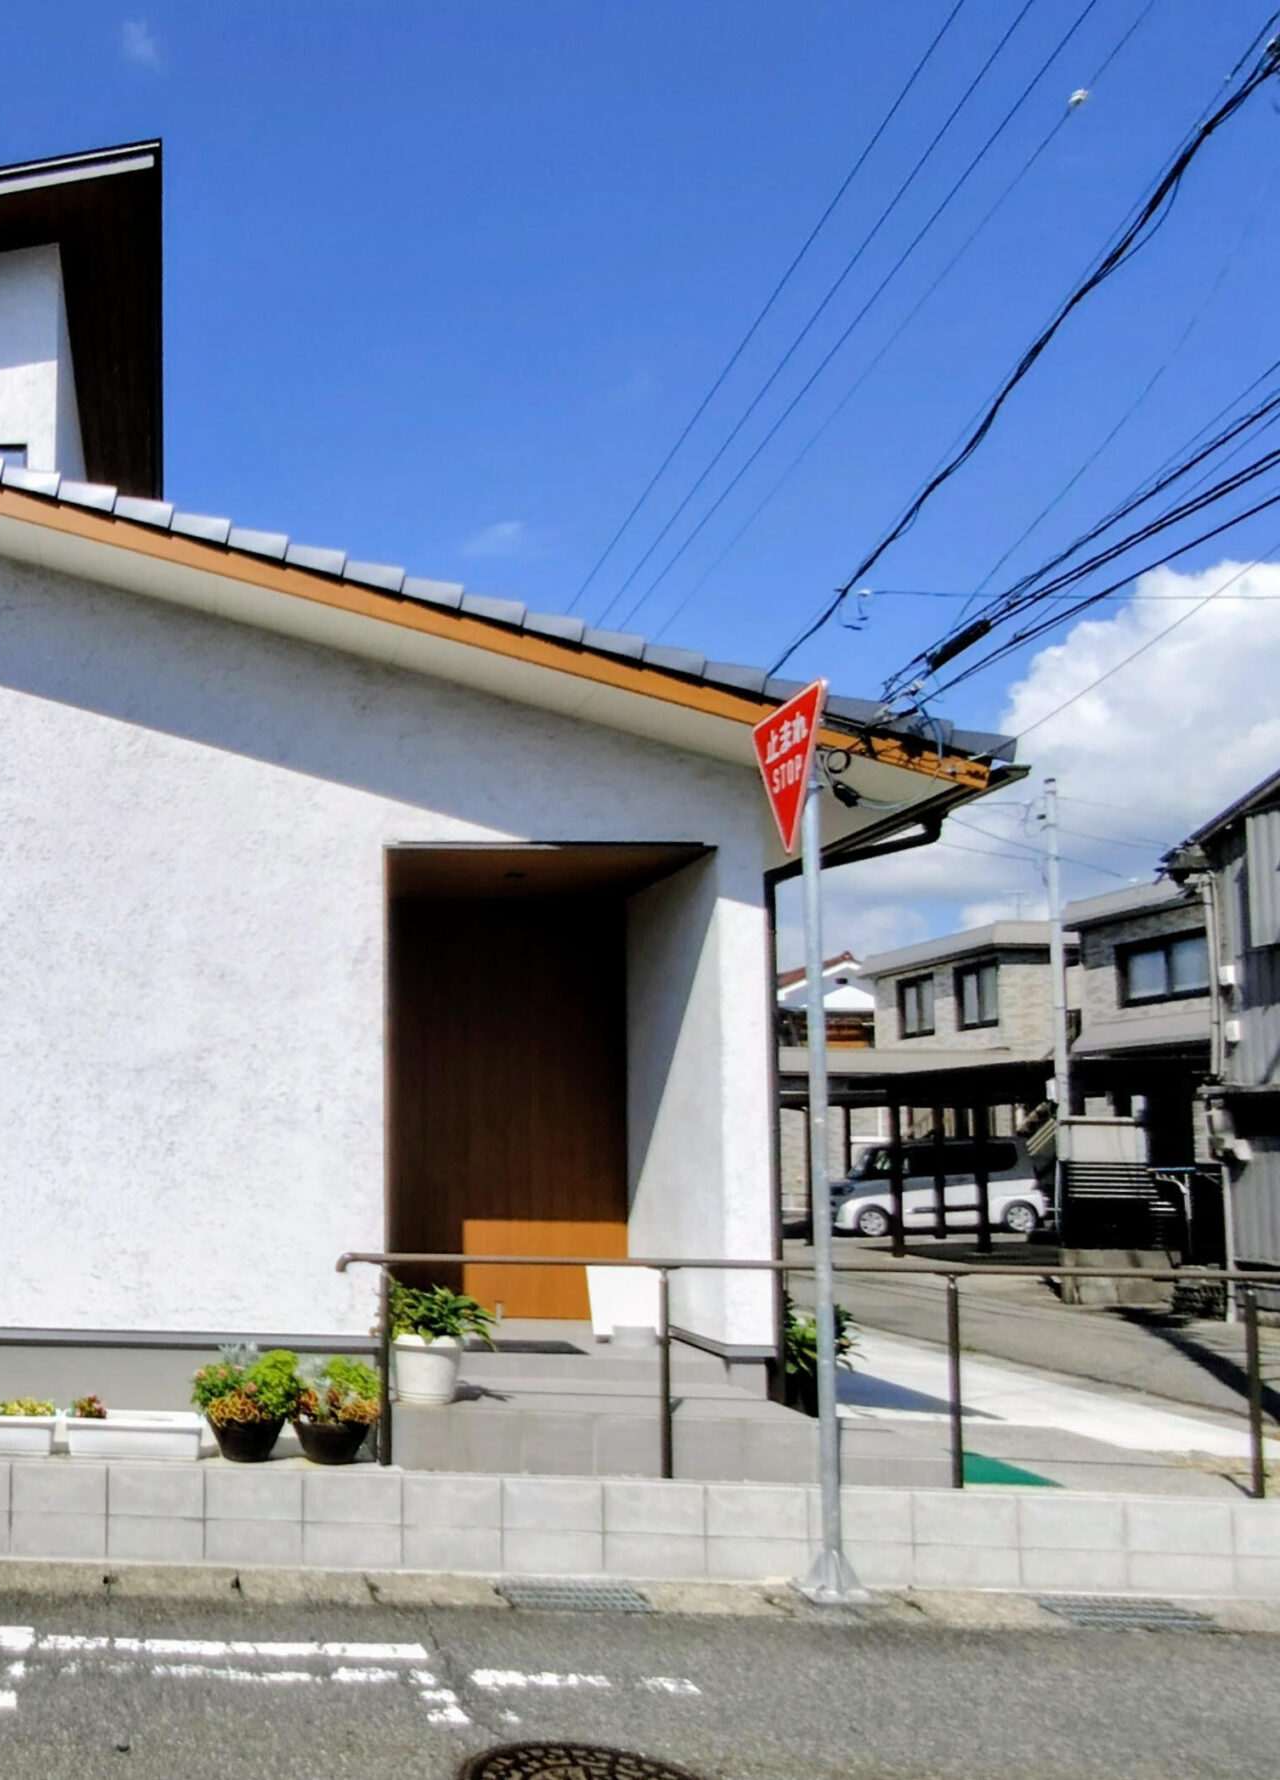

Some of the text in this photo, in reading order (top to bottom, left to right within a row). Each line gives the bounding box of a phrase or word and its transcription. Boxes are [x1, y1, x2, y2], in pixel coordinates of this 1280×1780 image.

[764, 711, 809, 765] 止まれ
[772, 754, 803, 795] STOP
